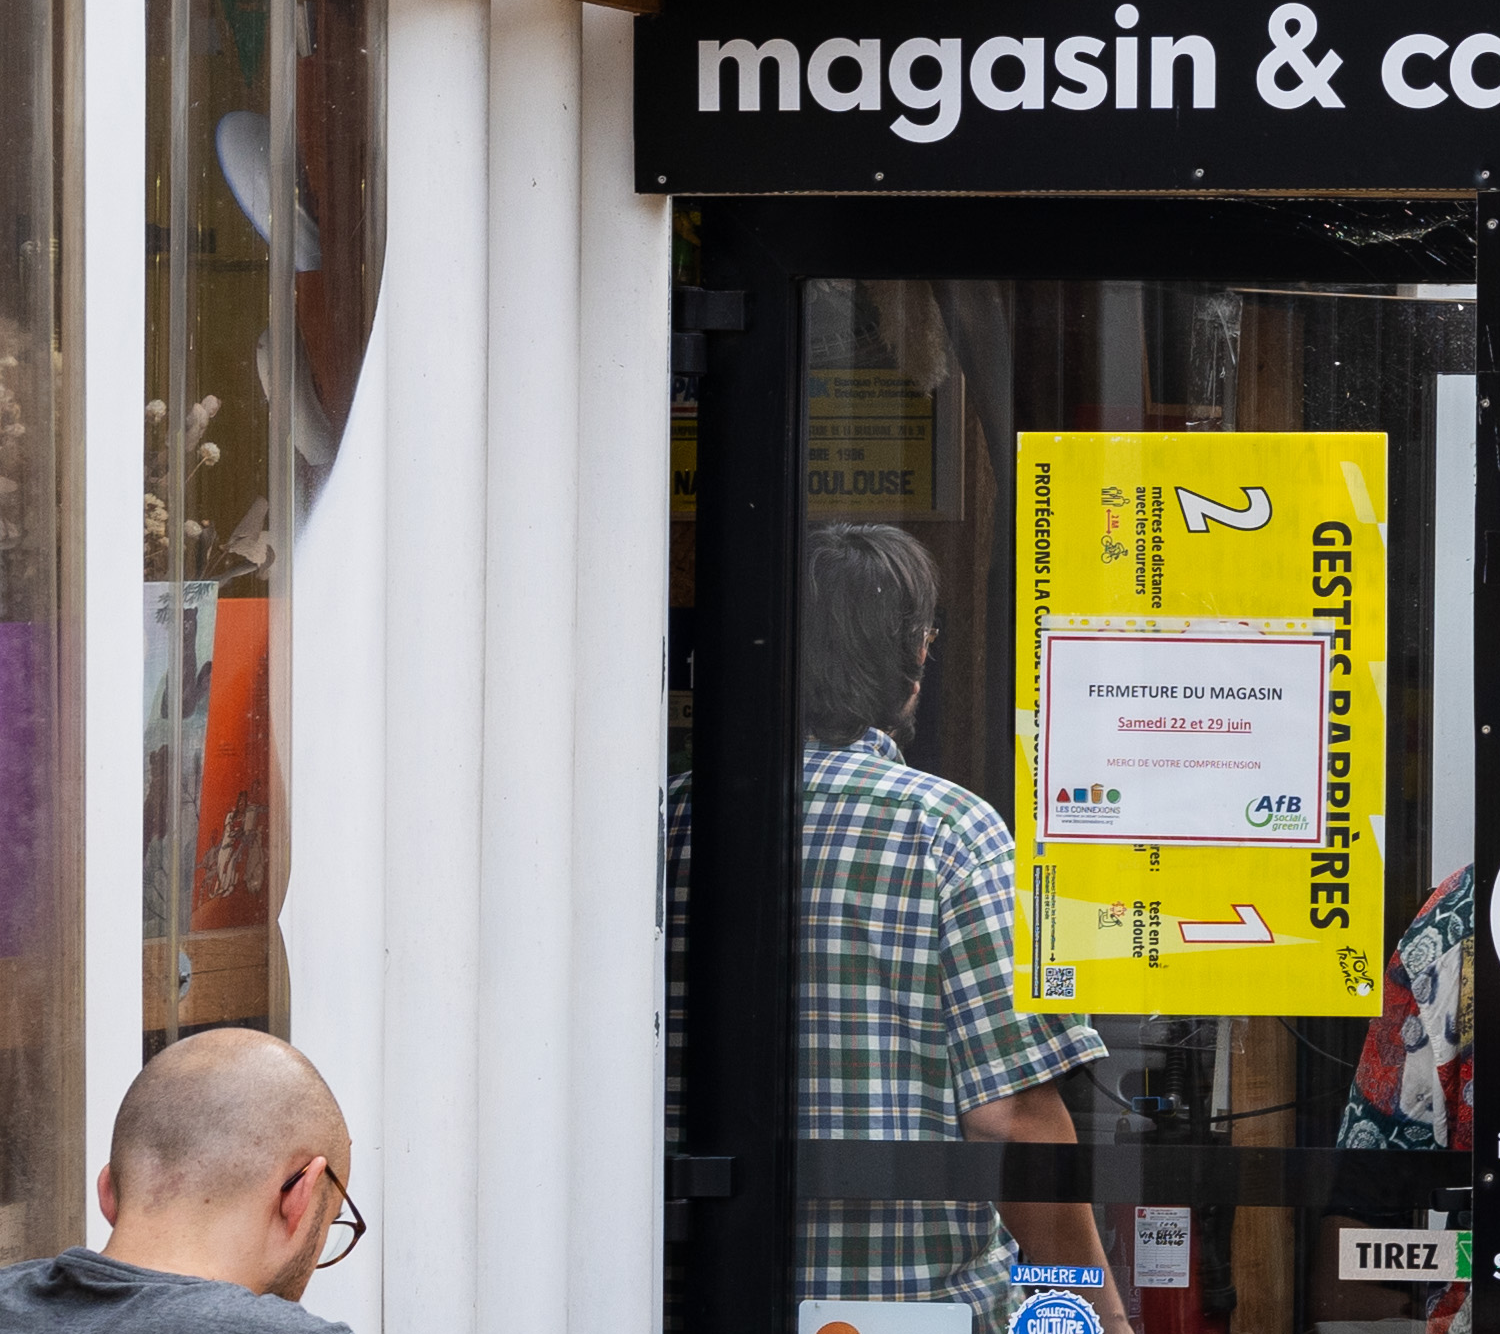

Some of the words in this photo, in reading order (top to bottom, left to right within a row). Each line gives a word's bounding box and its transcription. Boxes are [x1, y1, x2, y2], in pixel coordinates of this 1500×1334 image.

[696, 3, 1216, 144] magasin
[1256, 1, 1346, 110] &
[808, 470, 915, 496] OULOUSE
[1136, 486, 1146, 517] avec
[1151, 486, 1163, 533] mètres
[1034, 463, 1055, 573] PROTÉGEONS
[1136, 518, 1147, 535] les
[1151, 534, 1164, 551] de
[1135, 536, 1146, 595] coureurs
[1034, 579, 1050, 601] LA
[1151, 553, 1165, 609] distance
[1088, 684, 1179, 699] FERMETURE
[1183, 685, 1205, 699] DU
[1210, 686, 1283, 701] MAGASIN
[1117, 717, 1167, 731] Samedi
[1170, 718, 1187, 730] 22
[1190, 719, 1204, 731] et
[1207, 719, 1224, 731] 29
[1227, 719, 1252, 733] juin
[1107, 758, 1136, 768] MERCI
[1138, 758, 1150, 768] DE
[1152, 758, 1181, 769] VOTRE
[1183, 759, 1262, 770] COMPREHENSION
[1056, 805, 1070, 815] LES
[1071, 805, 1121, 815] CONNEXIONS
[1254, 795, 1302, 813] AfB
[1273, 813, 1302, 823] social
[1133, 901, 1145, 914] de
[1149, 901, 1161, 927] test
[1133, 916, 1145, 959] doute
[1149, 930, 1159, 944] en
[1149, 946, 1159, 969] cas
[1356, 1242, 1439, 1270] TIREZ
[1013, 1265, 1076, 1283] J'ADHÈRE
[1081, 1269, 1100, 1283] AU
[1036, 1307, 1076, 1319] COLLECTIF
